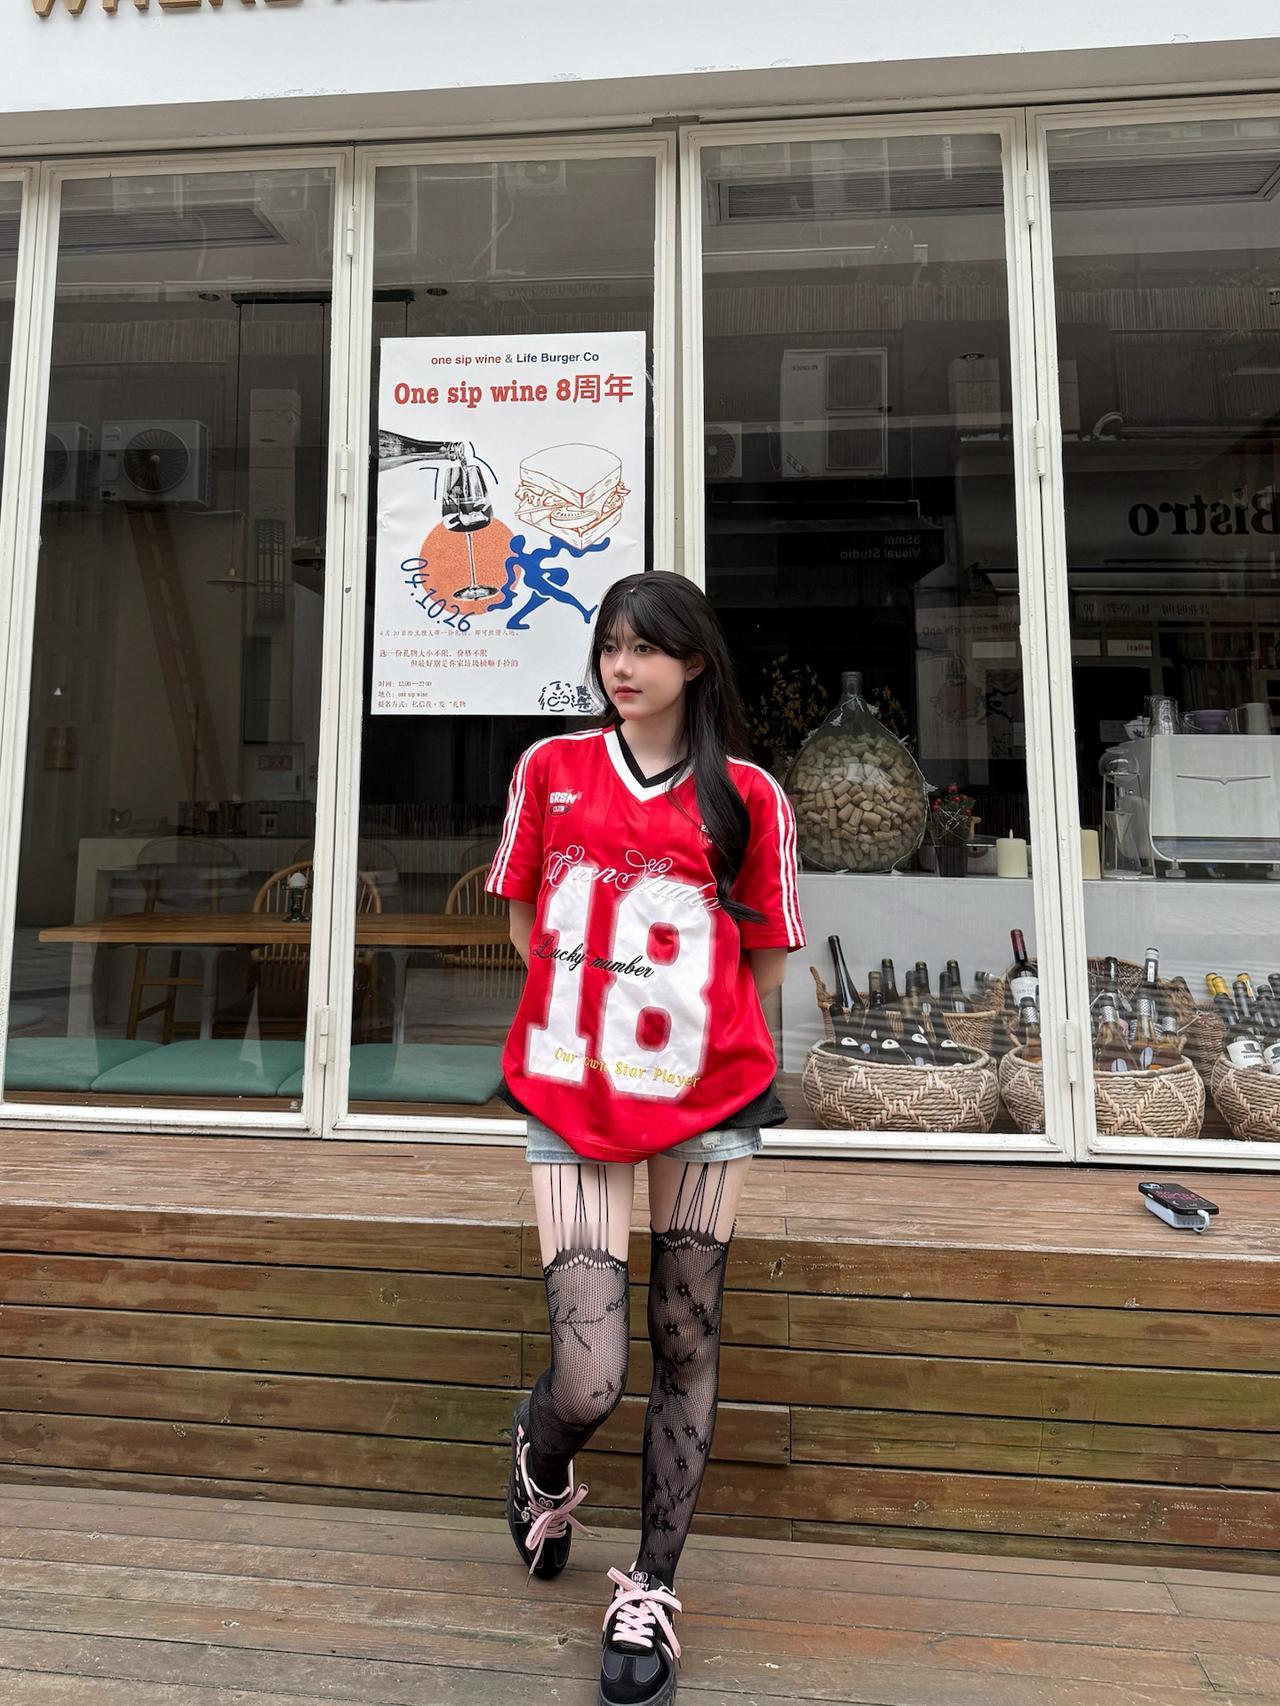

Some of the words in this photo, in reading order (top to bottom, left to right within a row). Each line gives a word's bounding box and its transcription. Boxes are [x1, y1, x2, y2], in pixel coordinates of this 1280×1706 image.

[431, 356, 452, 365] one
[455, 354, 472, 366] sip
[475, 354, 502, 365] wine
[505, 354, 513, 363] &
[516, 353, 538, 363] Life
[394, 382, 439, 404] One
[447, 381, 482, 408] sip
[490, 379, 548, 402] wine
[556, 373, 634, 404] 8周年
[533, 933, 586, 971] Lucky
[589, 956, 654, 979] number
[526, 863, 714, 1100] 18
[554, 1047, 578, 1064] Our
[584, 1056, 608, 1072] own
[615, 1061, 646, 1079] Star
[653, 1068, 701, 1088] Player
